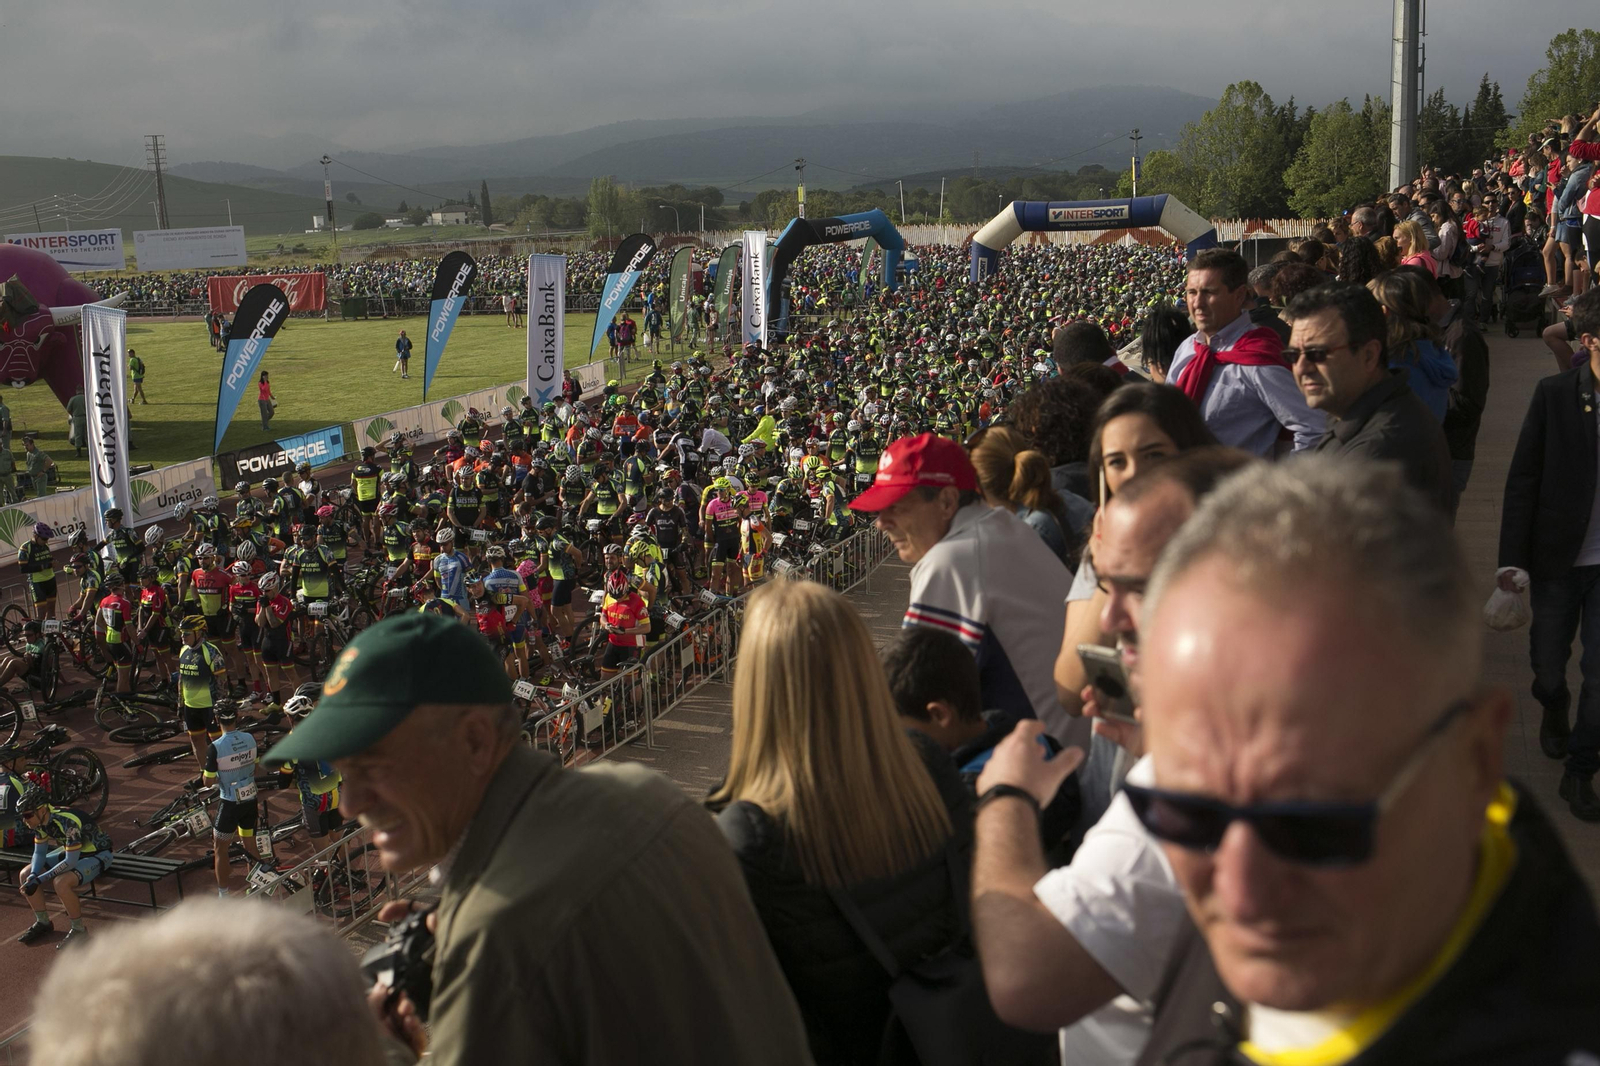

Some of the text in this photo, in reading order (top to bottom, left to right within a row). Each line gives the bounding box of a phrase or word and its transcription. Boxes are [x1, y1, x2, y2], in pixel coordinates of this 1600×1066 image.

[1059, 220, 1119, 228] www.intersport.es
[1063, 207, 1125, 220] INTERSPORT
[825, 220, 872, 237] POWERADE
[23, 233, 117, 249] INTERSPORT
[604, 243, 653, 310] POWERADE
[679, 273, 688, 302] Unicaja
[724, 269, 734, 295] Unicaja
[749, 252, 762, 328] CaixaBank
[431, 262, 473, 343] POWERADE
[536, 281, 555, 382] CaixaBank
[226, 298, 285, 390] POWERADE
[92, 343, 116, 489] CaixaBank
[157, 485, 203, 508] Unicaja
[52, 517, 87, 539] nicaja
[517, 685, 531, 695] 7514
[230, 750, 252, 762] enjoy!
